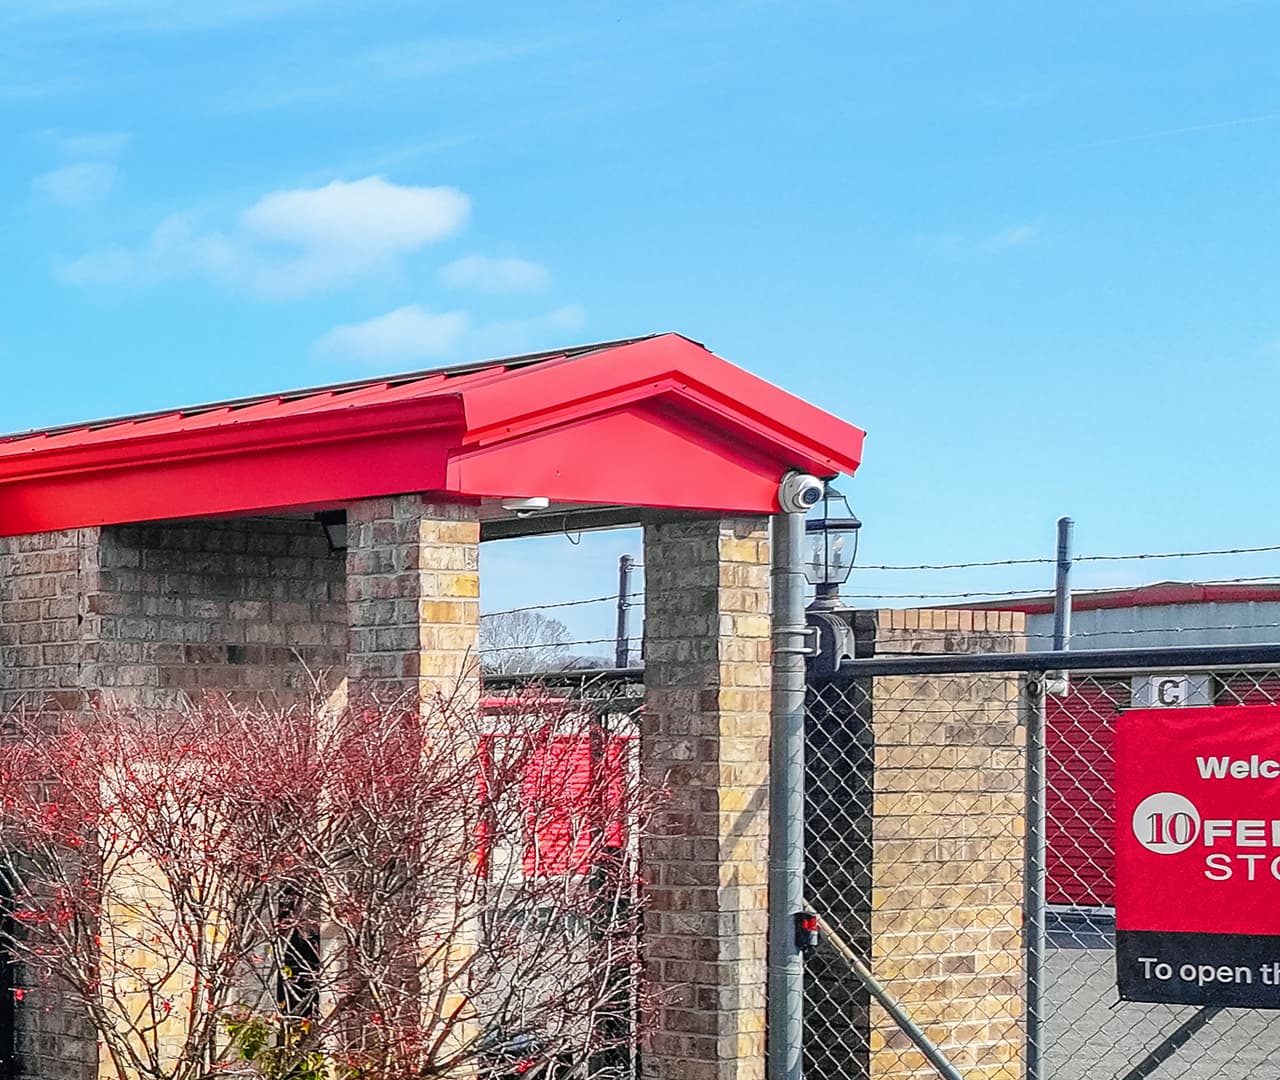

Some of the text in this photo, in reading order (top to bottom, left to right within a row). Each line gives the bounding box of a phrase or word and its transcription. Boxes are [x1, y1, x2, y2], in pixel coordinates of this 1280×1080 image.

[1156, 680, 1181, 707] C
[1196, 755, 1280, 779] Welc
[1146, 812, 1280, 847] 10 FE
[1137, 957, 1173, 980] To
[1179, 963, 1252, 987] open
